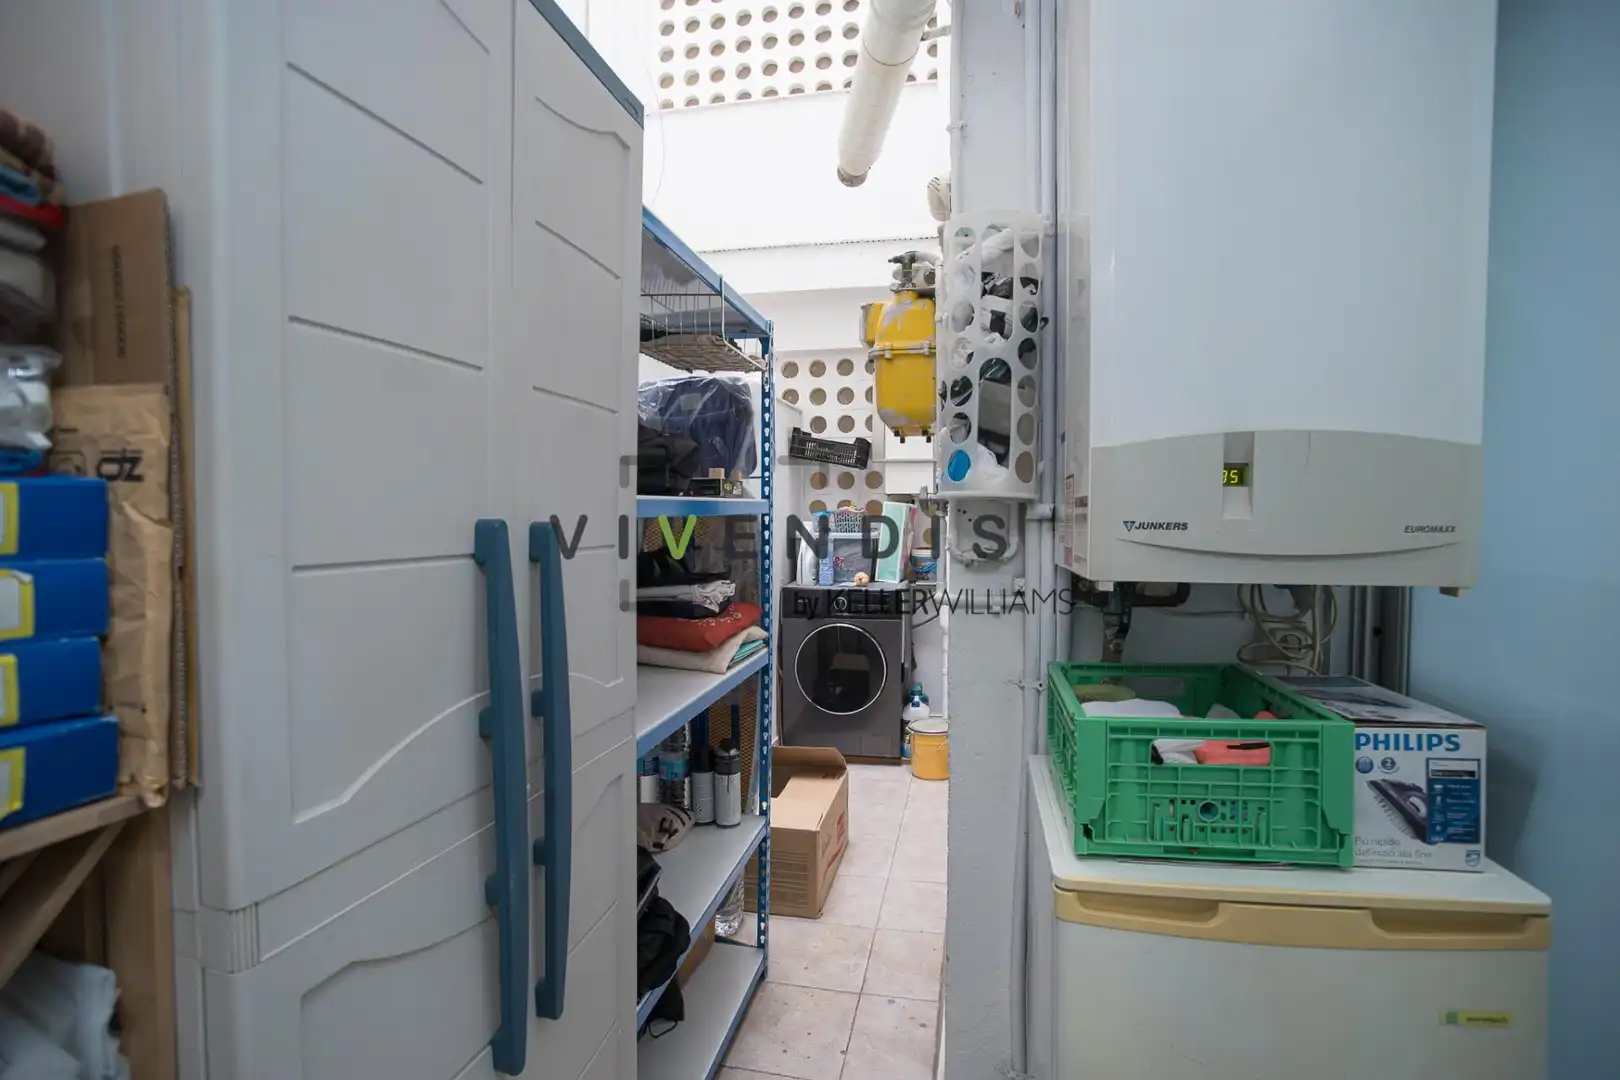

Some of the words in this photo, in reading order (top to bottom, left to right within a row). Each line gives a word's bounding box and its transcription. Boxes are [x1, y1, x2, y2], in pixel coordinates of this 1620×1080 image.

[1134, 520, 1189, 531] JUNKERS
[1403, 524, 1457, 534] EUROMAXX
[1354, 732, 1461, 752] PHILIPS
